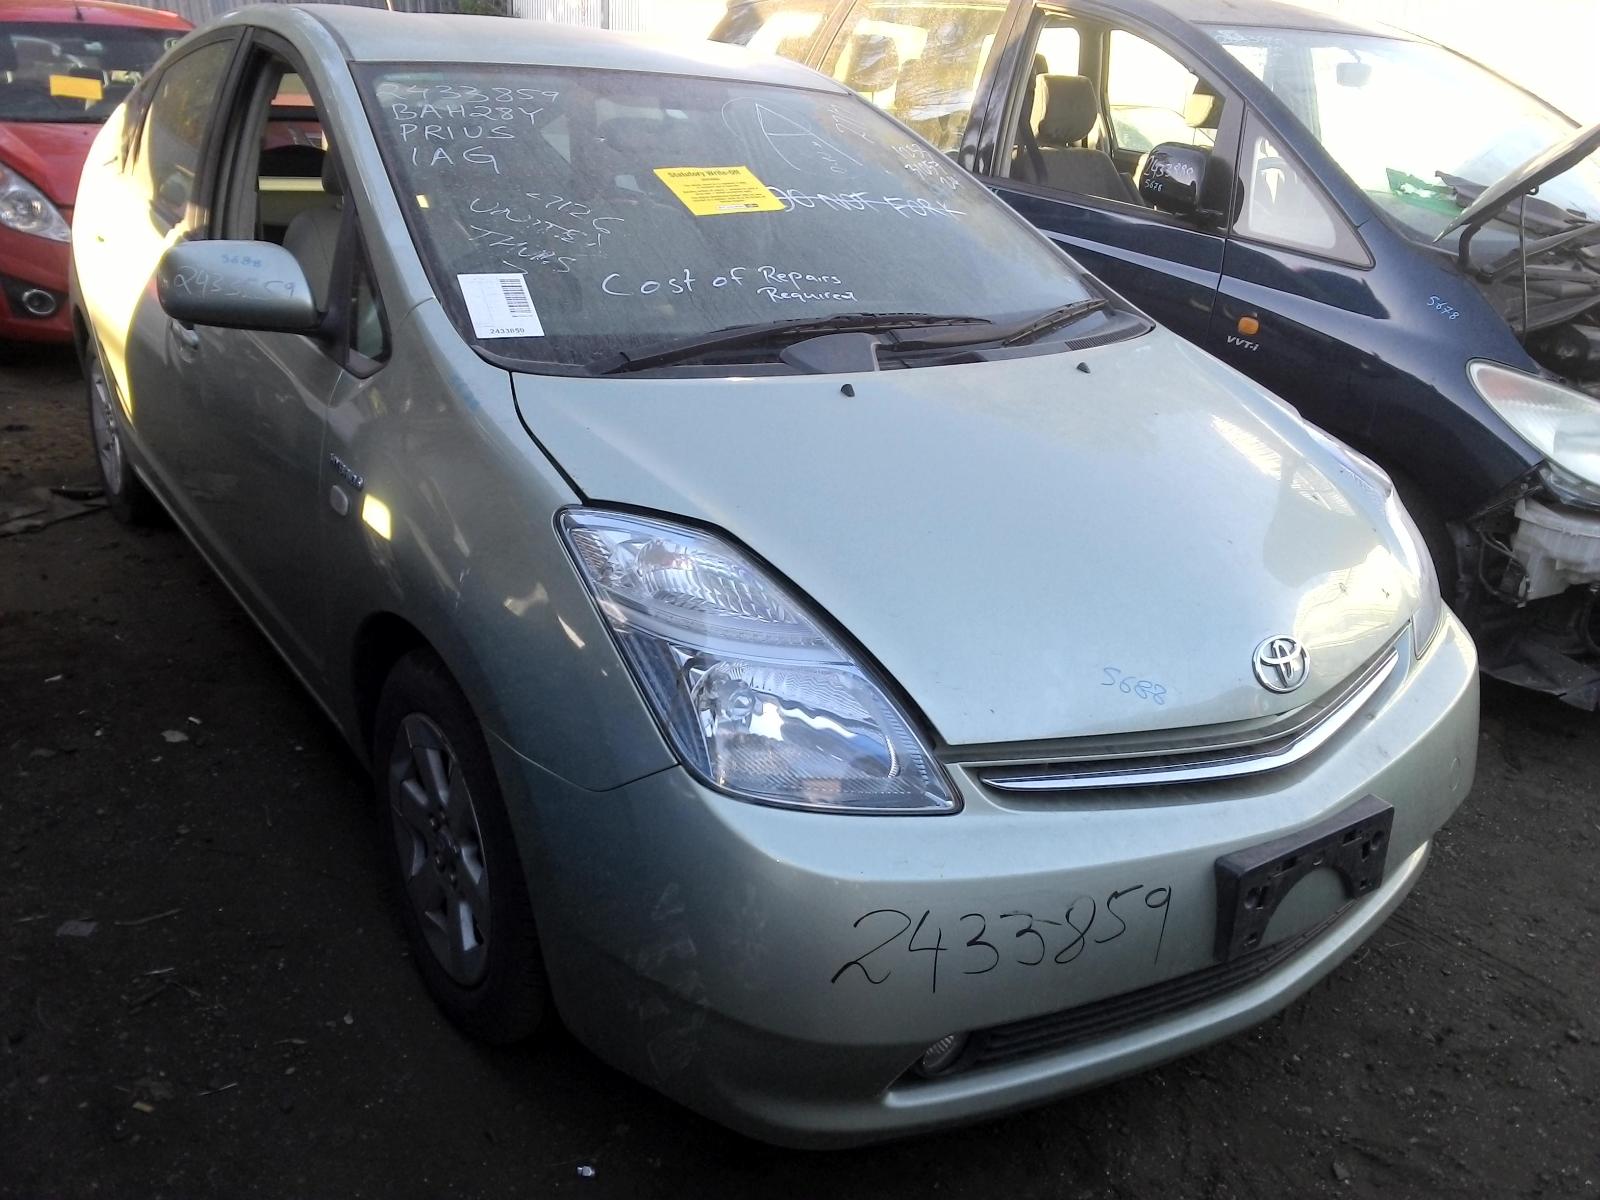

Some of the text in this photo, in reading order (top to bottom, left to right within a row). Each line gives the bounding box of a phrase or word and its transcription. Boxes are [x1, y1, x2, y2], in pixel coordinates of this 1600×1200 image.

[376, 84, 560, 103] 2433859
[391, 103, 544, 126] BAH28Y
[399, 123, 516, 142] PRIUS
[601, 265, 842, 297] Cost of Repairs
[756, 286, 859, 303] Required
[831, 886, 1172, 994] 2433859
